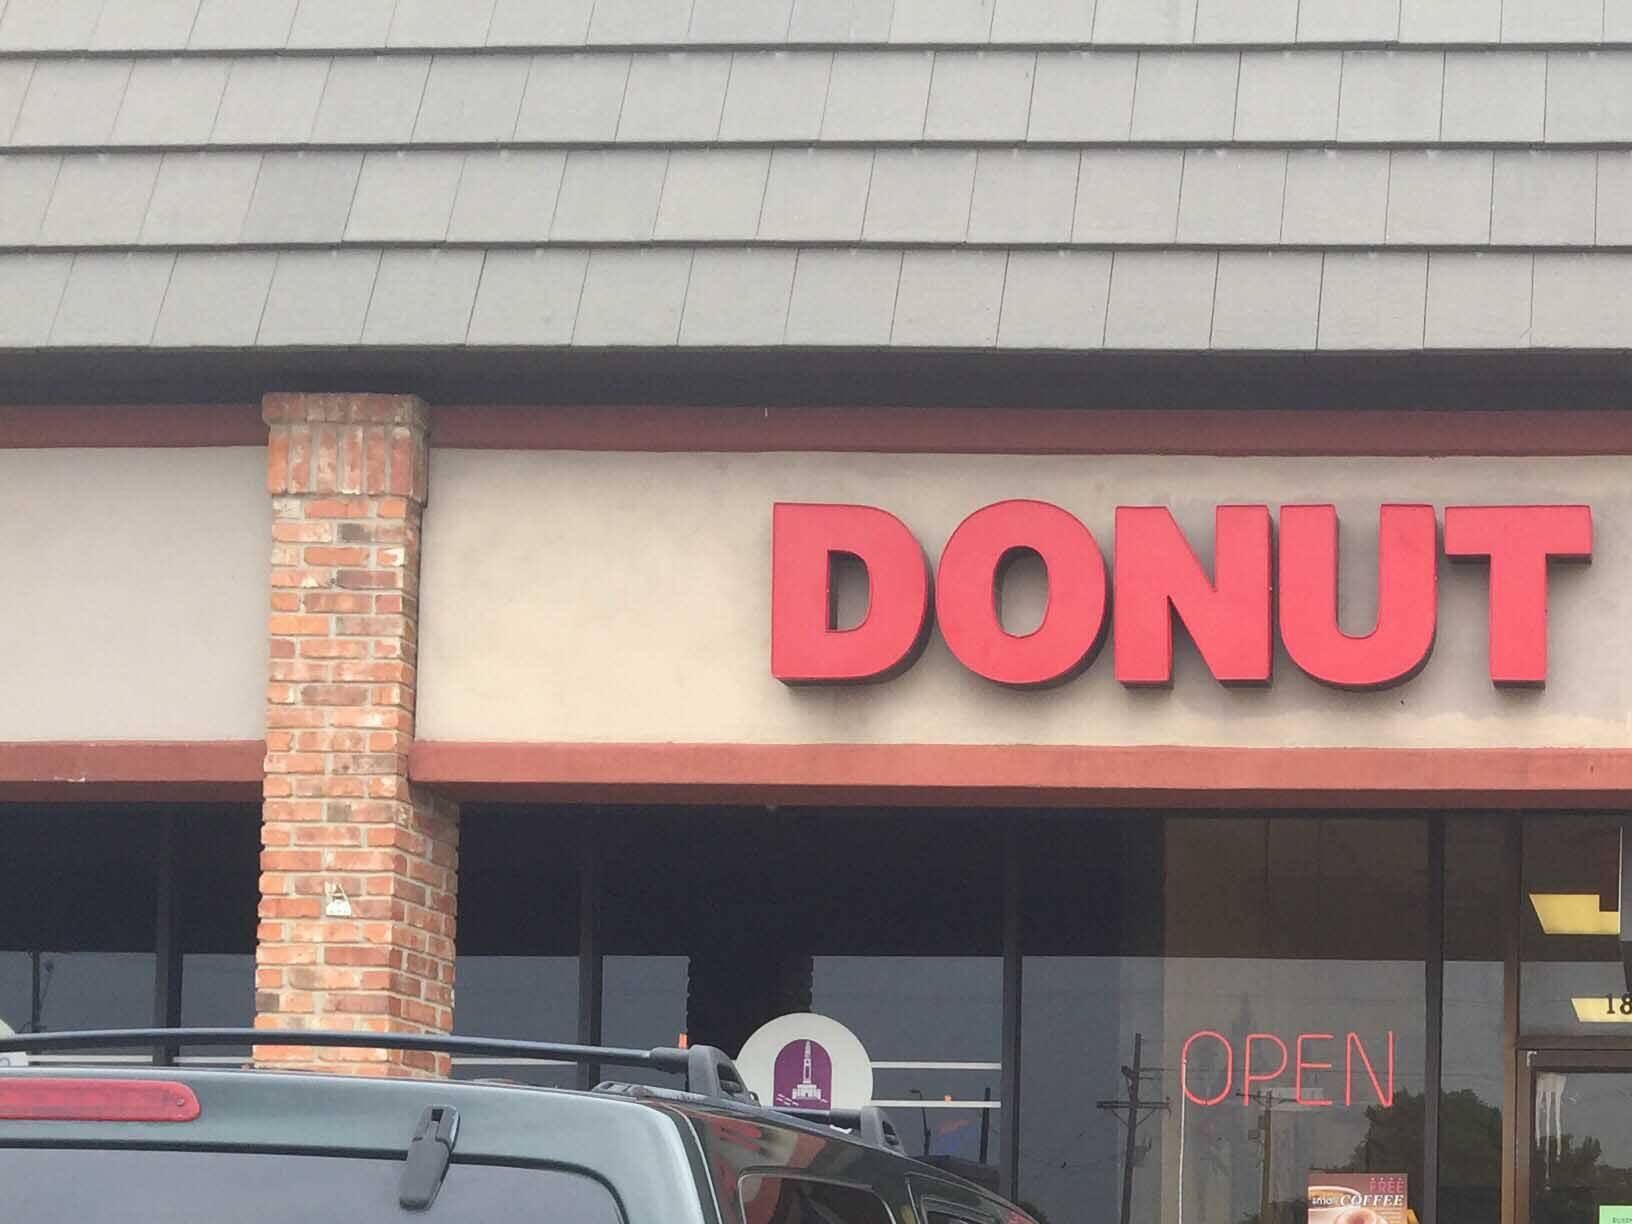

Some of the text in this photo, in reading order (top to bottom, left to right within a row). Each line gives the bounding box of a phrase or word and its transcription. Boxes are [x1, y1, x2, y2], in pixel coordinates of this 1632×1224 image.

[770, 497, 1592, 688] DONUT
[1180, 1030, 1395, 1108] OPEN
[1339, 1194, 1405, 1207] COFFEE
[1369, 1179, 1405, 1194] FREE
